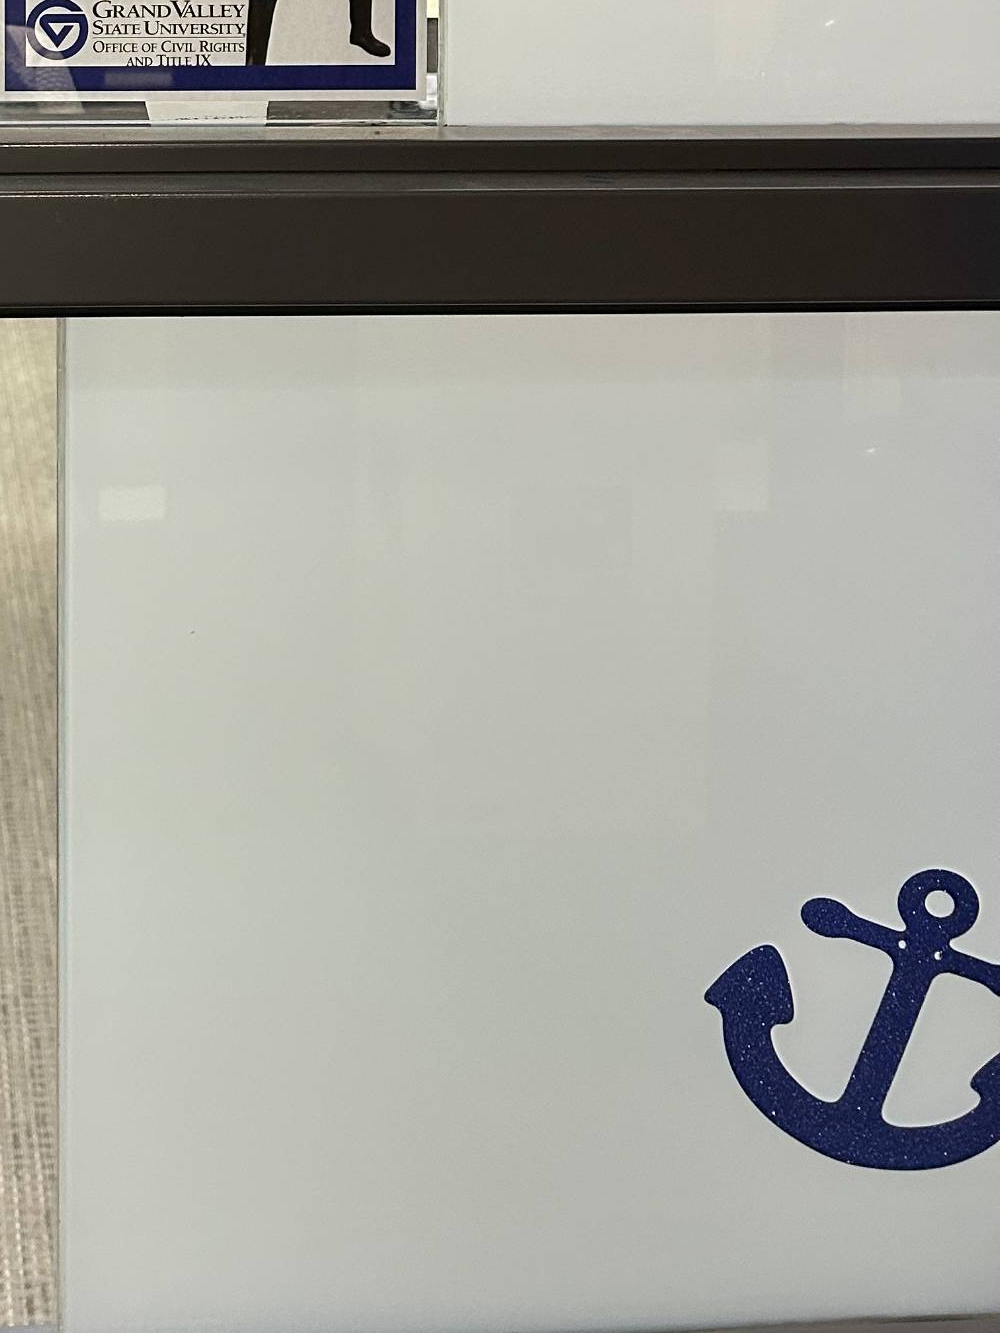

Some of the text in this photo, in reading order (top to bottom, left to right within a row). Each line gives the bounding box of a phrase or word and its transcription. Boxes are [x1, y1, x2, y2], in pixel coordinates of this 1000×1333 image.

[92, 20, 141, 35] STATE
[93, 40, 245, 53] OFFICE OF CIVIL RIGHTS
[127, 54, 212, 66] AND TITLE IX
